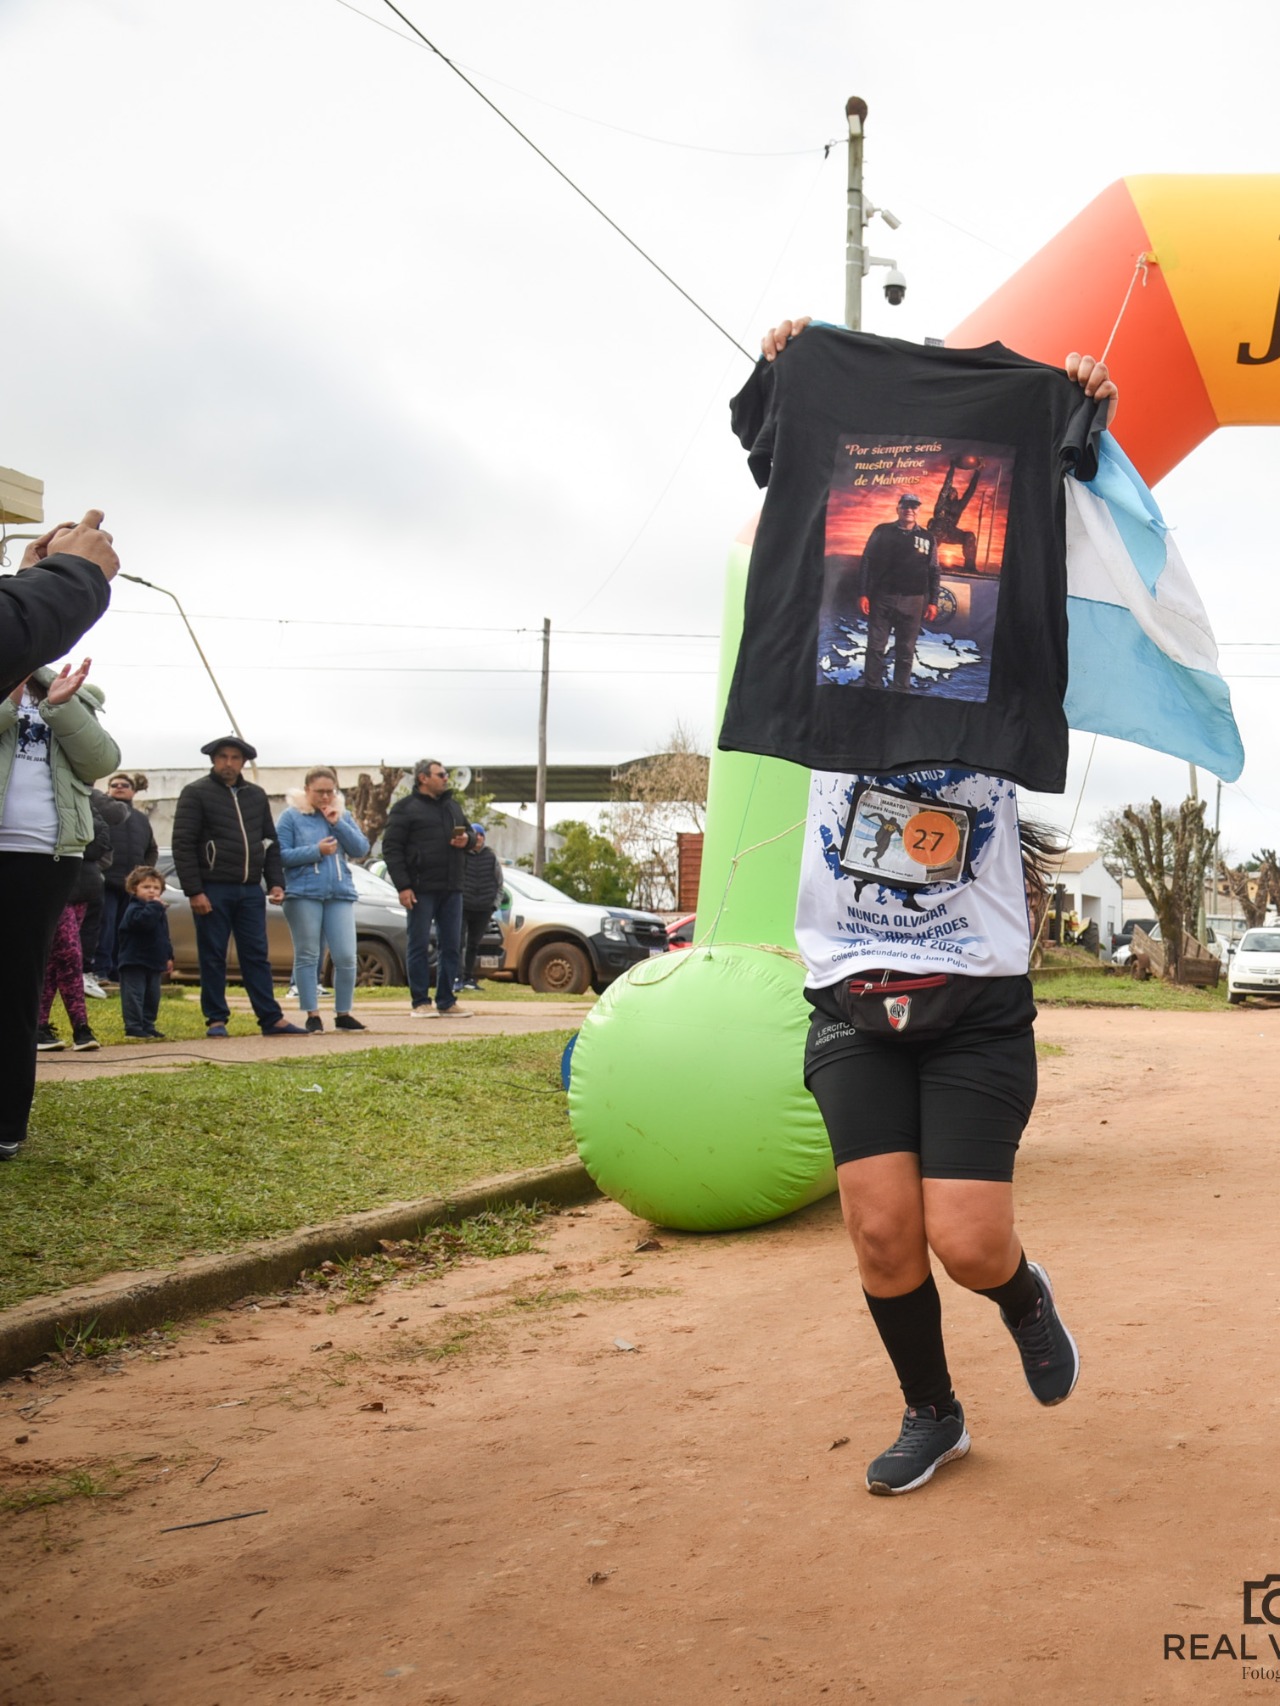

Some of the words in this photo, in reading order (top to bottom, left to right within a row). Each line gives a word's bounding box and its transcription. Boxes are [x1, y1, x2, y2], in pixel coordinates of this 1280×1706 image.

[871, 445, 912, 457] siempre
[914, 441, 942, 453] serás
[854, 460, 893, 470] nuestro
[896, 457, 925, 469] héroe
[854, 474, 868, 486] de
[913, 829, 945, 852] 27
[847, 906, 890, 926] NUNCA
[915, 917, 969, 941] HÉROES
[929, 940, 963, 955] 2026
[832, 949, 859, 963] Colegio
[860, 948, 909, 959] Secundario
[910, 953, 922, 961] de
